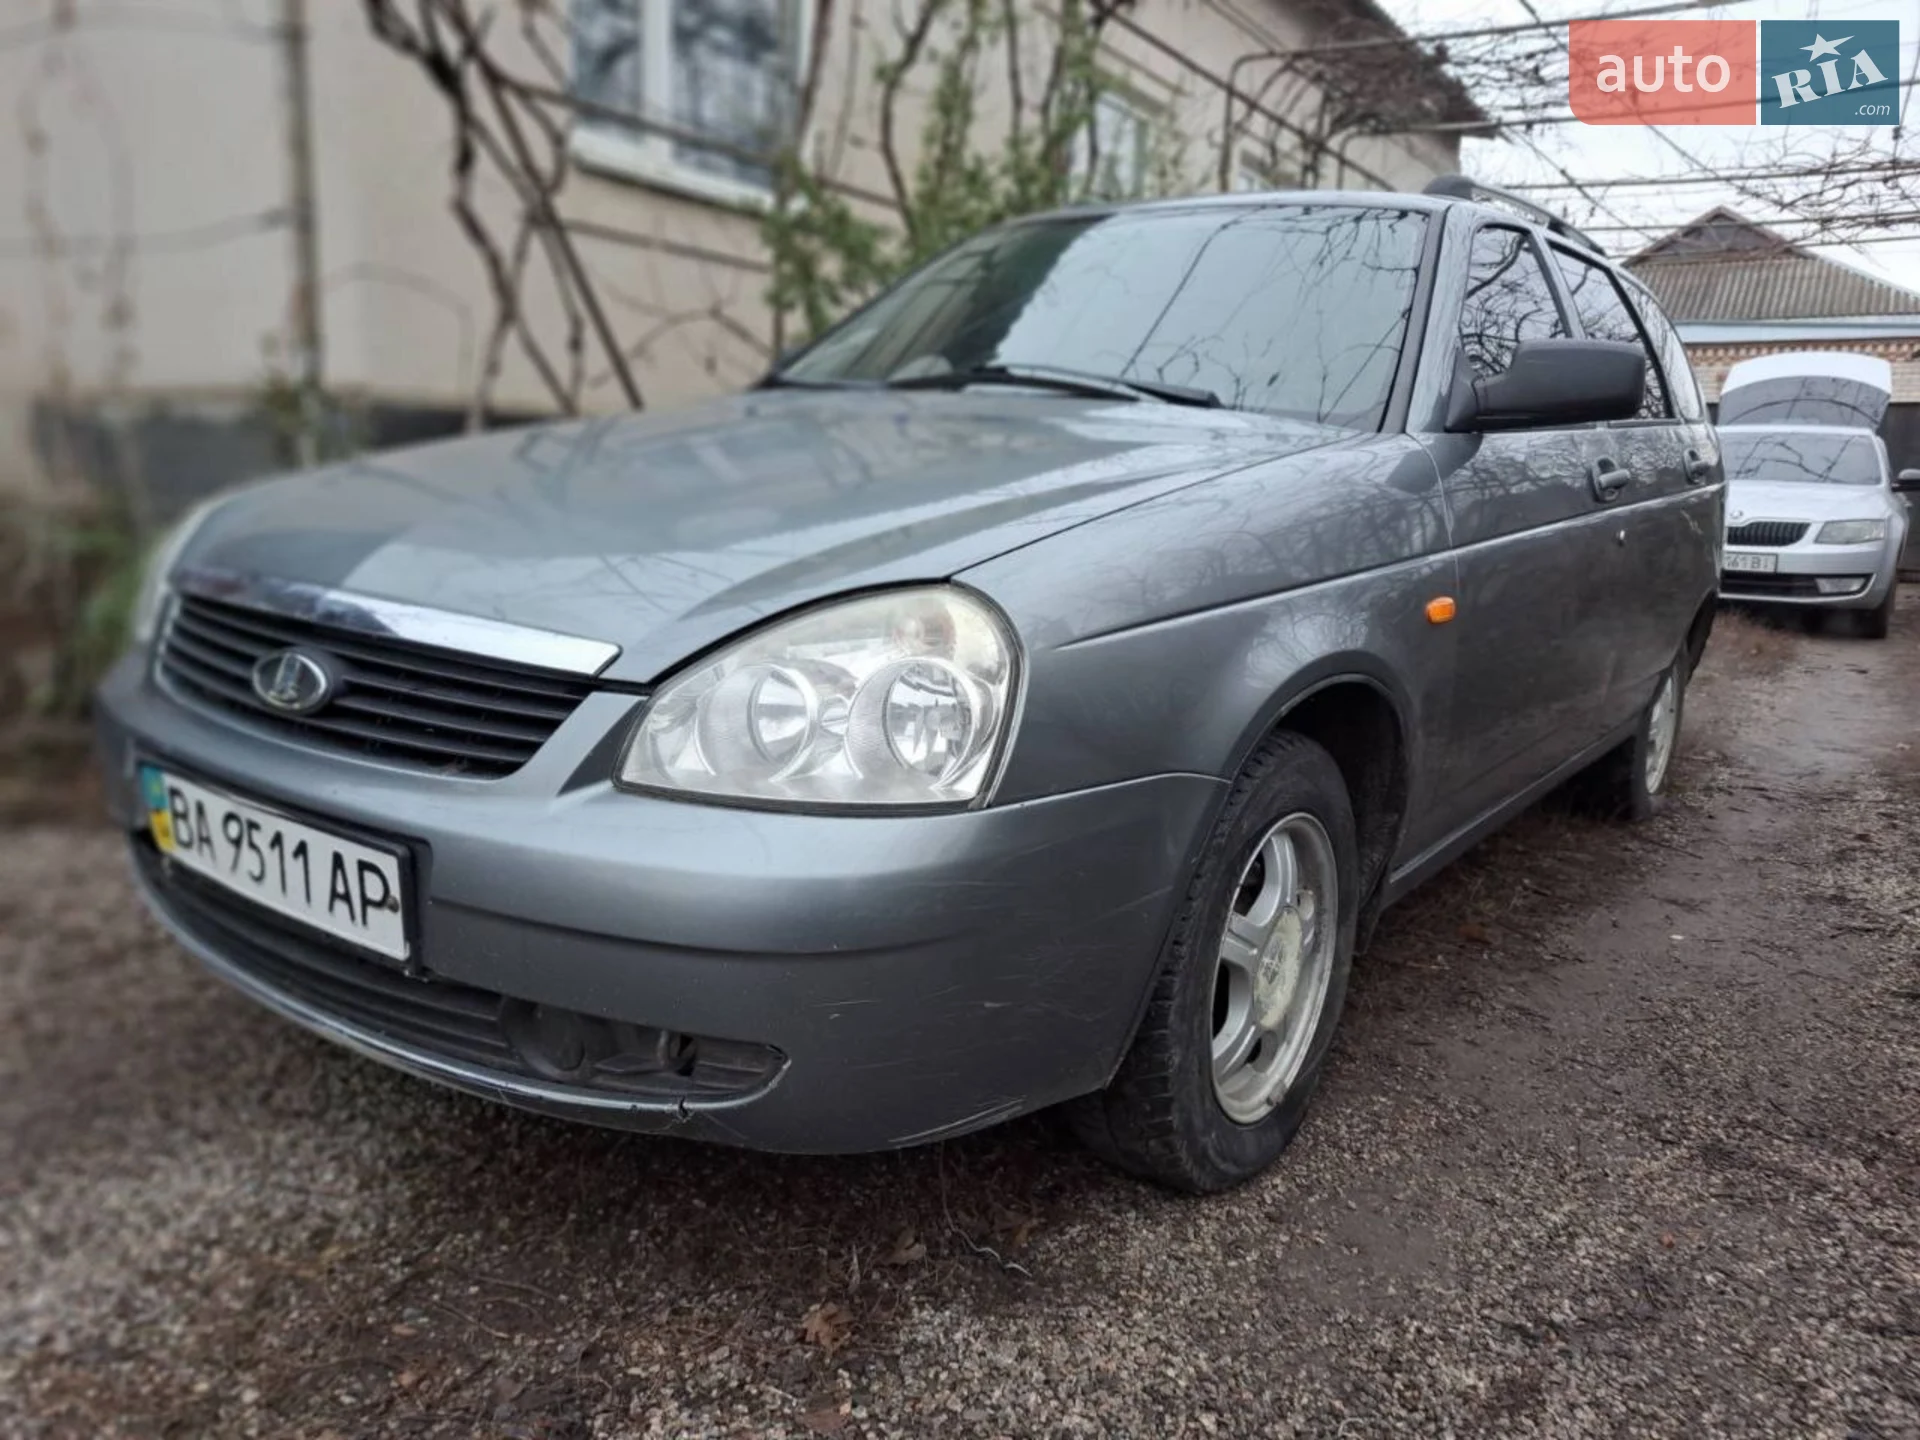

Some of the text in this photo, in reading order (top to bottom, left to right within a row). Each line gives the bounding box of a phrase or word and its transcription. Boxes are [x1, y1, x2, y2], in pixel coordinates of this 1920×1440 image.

[168, 785, 392, 928] BA 9511 AP
